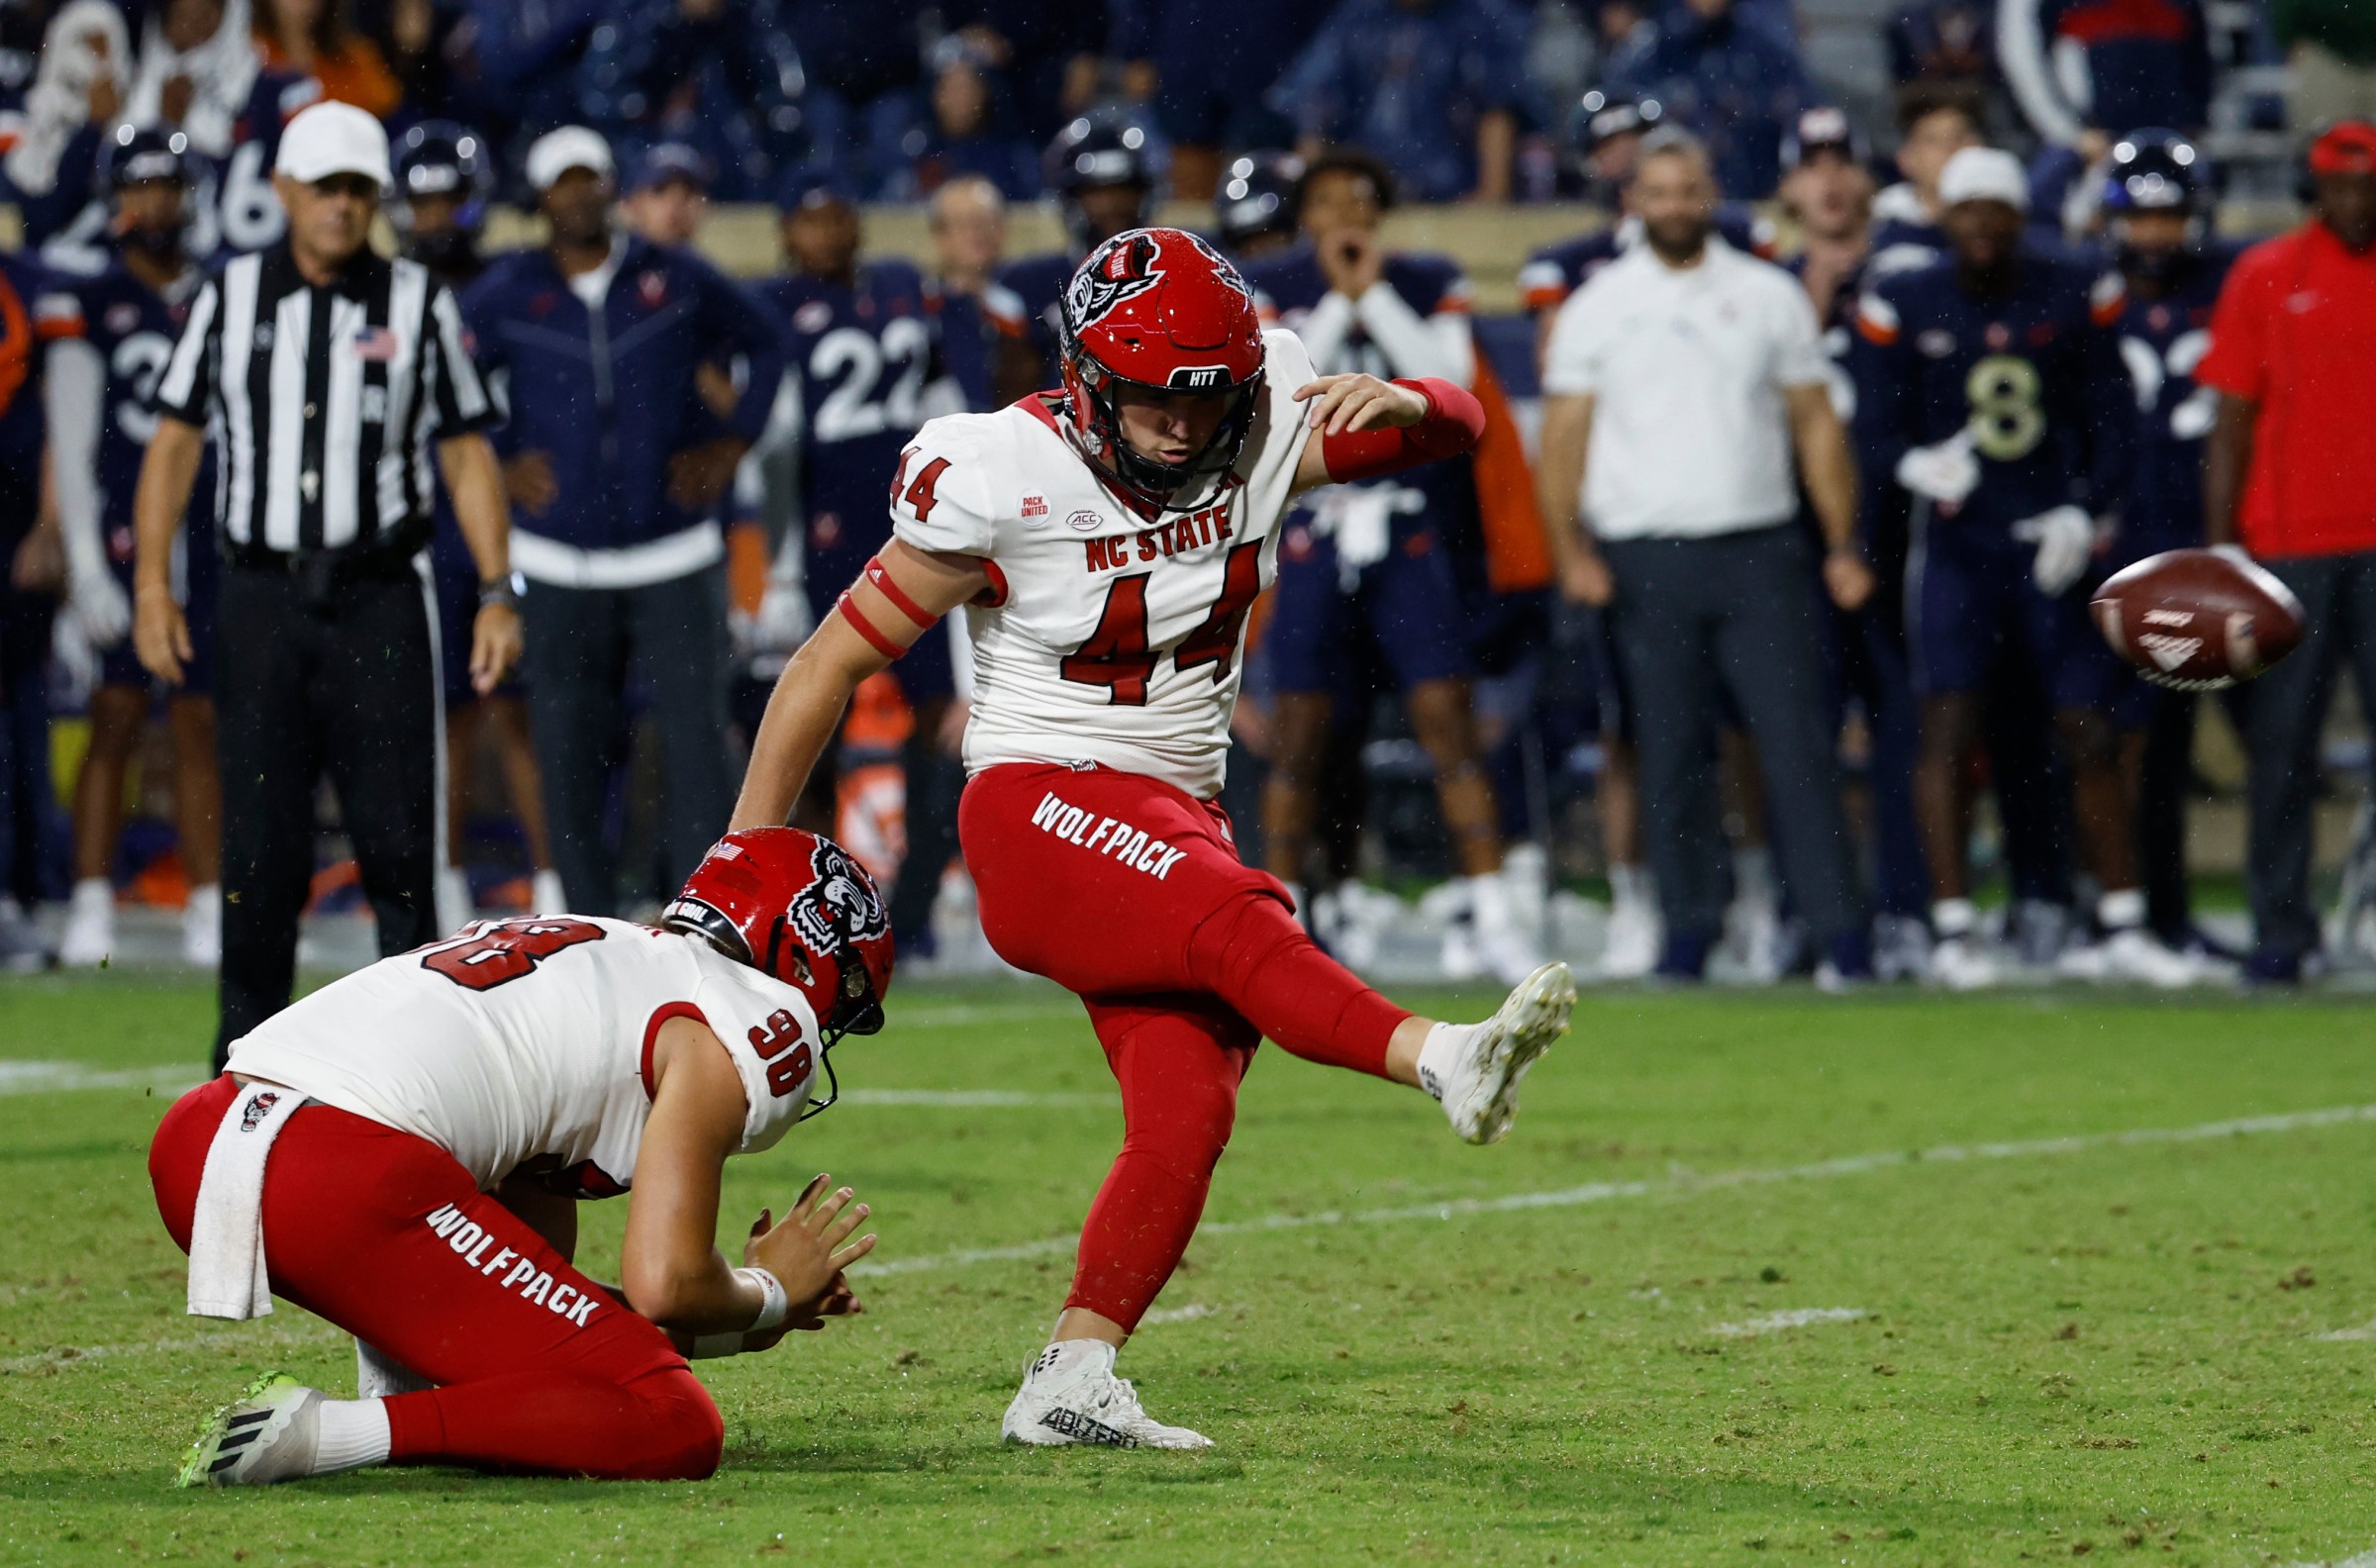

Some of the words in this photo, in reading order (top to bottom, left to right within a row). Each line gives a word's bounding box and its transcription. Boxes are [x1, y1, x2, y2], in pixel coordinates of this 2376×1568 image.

[808, 315, 933, 444] 22
[1189, 370, 1218, 387] HTT
[1966, 353, 2046, 462] 8
[890, 445, 953, 524] 44
[1021, 505, 1048, 518] UNITED
[1023, 496, 1043, 507] PACK
[1071, 514, 1097, 524] ACC
[1084, 535, 1130, 573] NC
[1136, 503, 1234, 562] STATE
[1059, 535, 1266, 708] 44
[1031, 790, 1189, 881] WOLFPACK
[747, 1008, 814, 1099] 98
[425, 1202, 601, 1328] WOLFPACK
